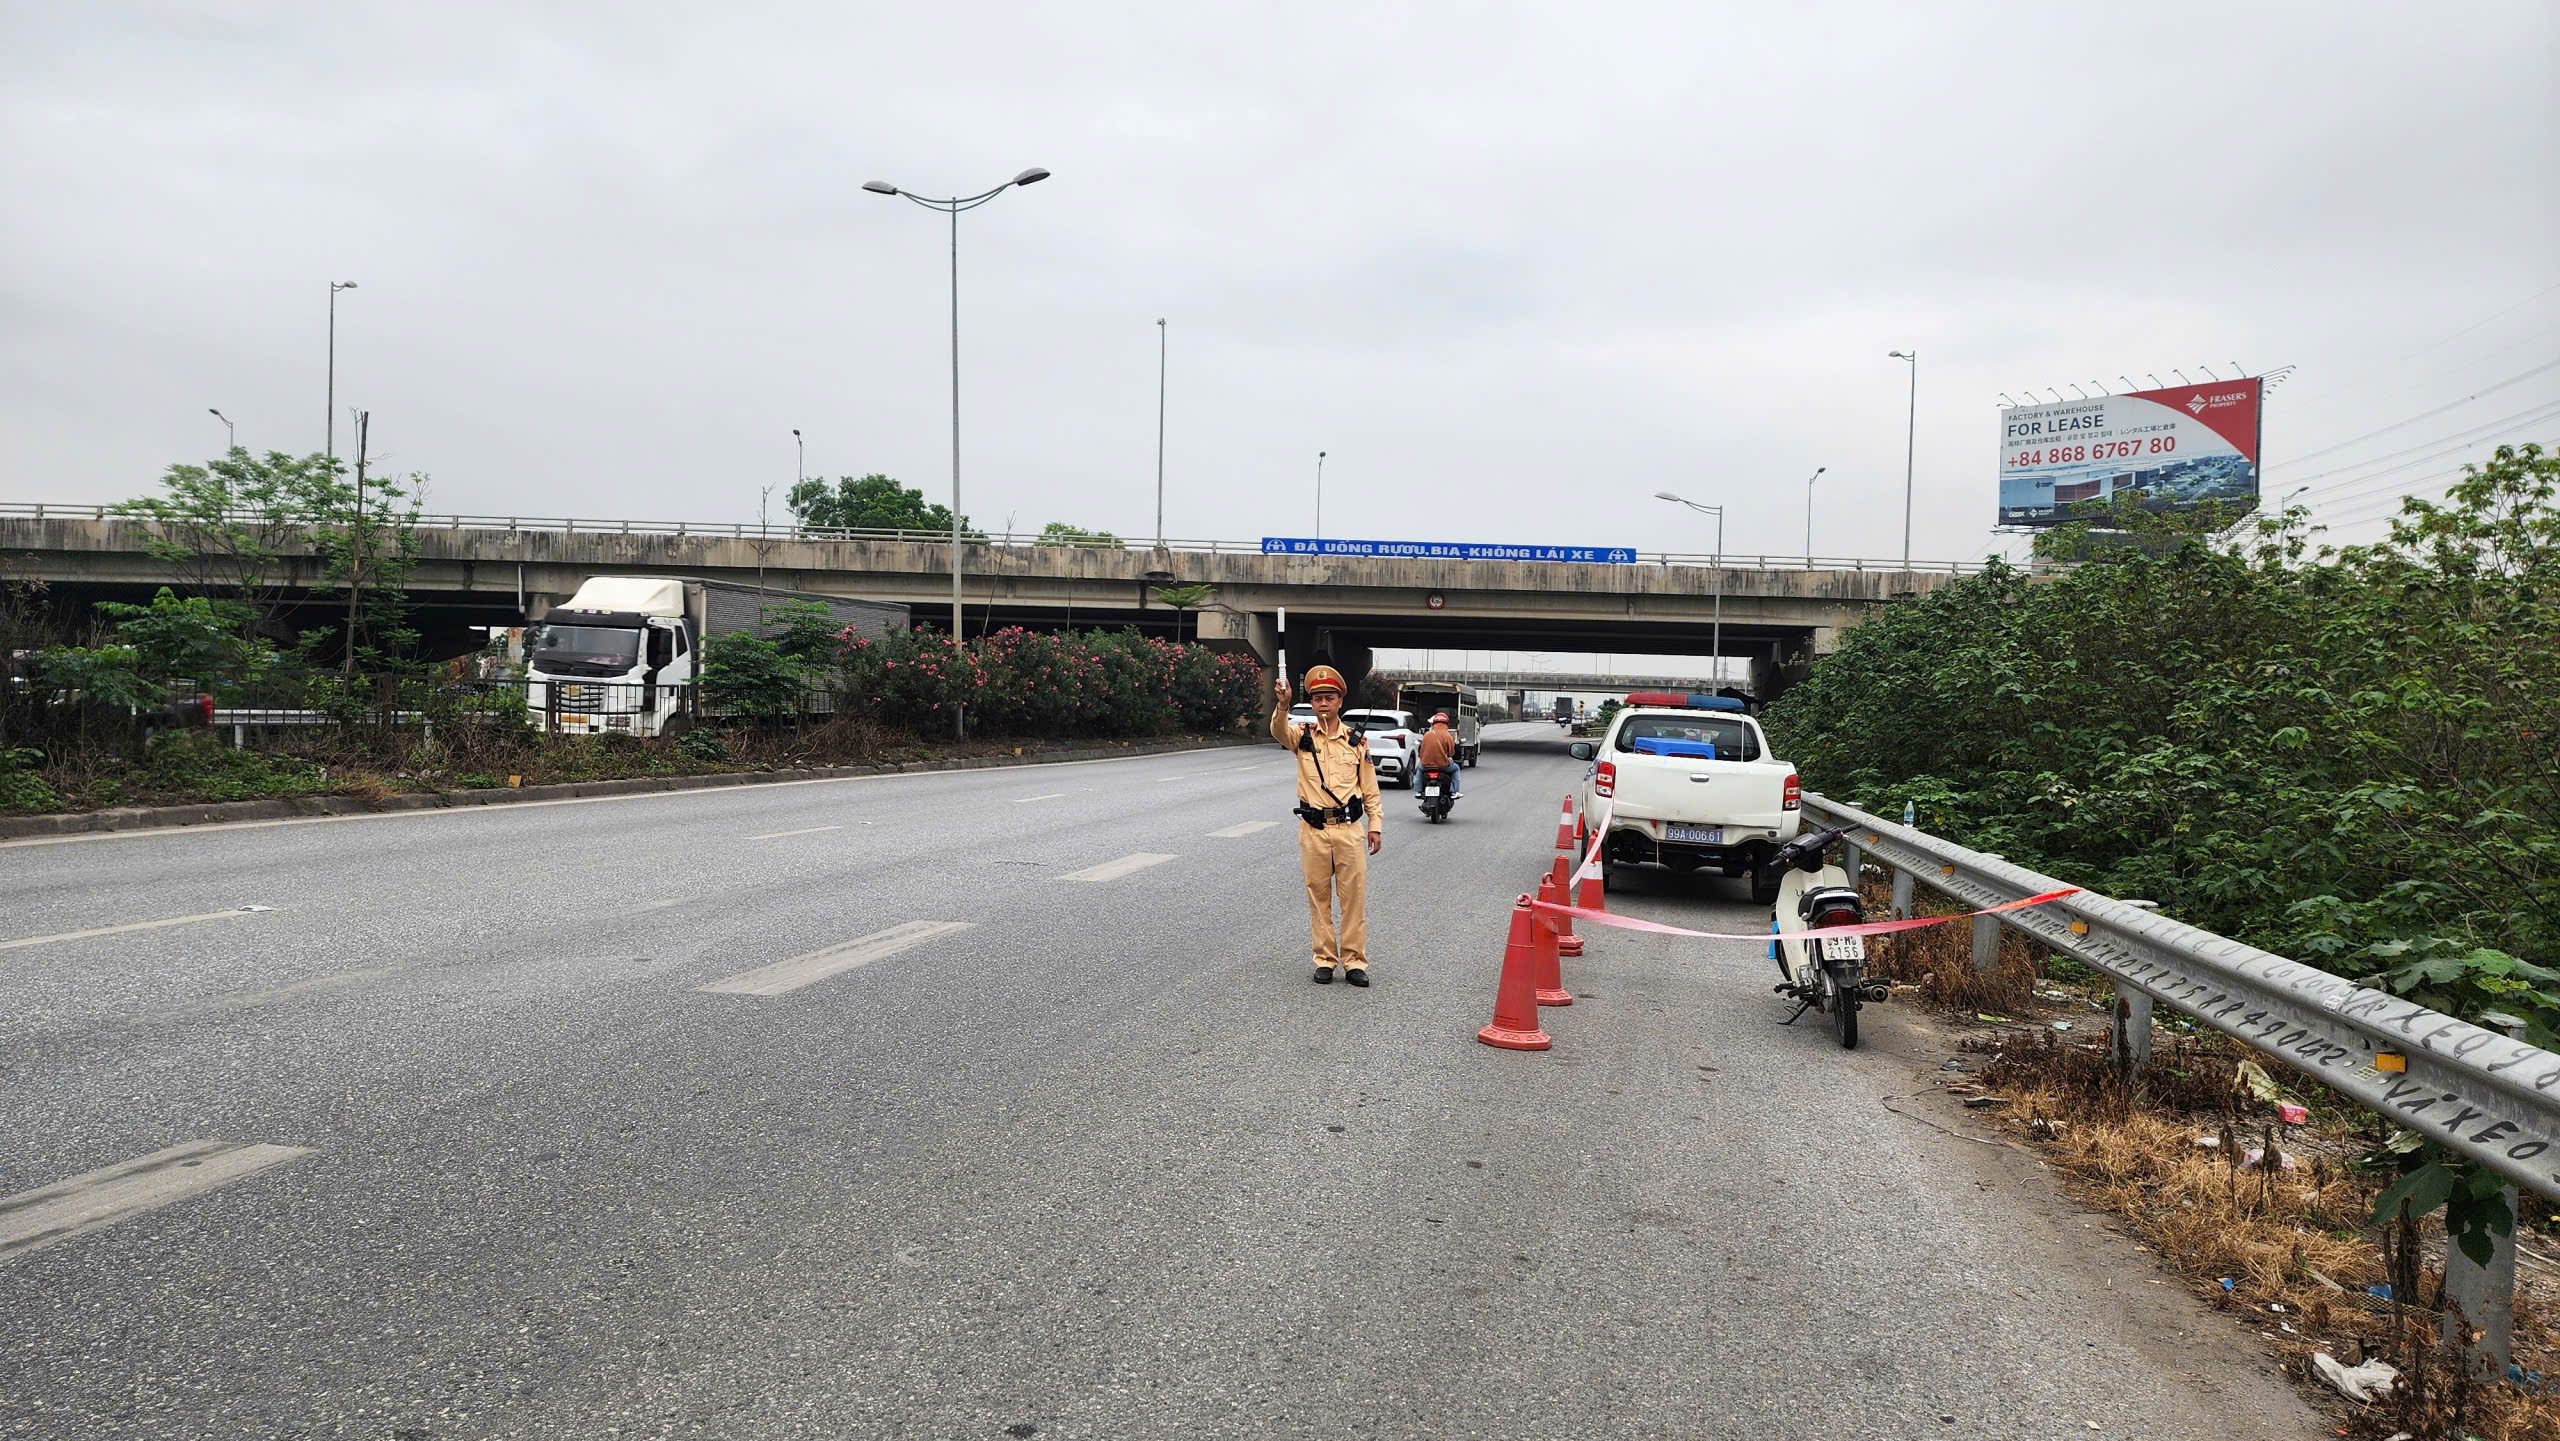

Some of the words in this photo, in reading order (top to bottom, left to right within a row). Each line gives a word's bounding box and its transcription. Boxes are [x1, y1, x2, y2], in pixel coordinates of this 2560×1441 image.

[2210, 392, 2247, 403] FRASERS
[2008, 411, 2044, 422] FACTORY
[2053, 404, 2104, 417] WAREHOUSE
[2008, 422, 2042, 437] FOR
[2048, 414, 2104, 433] LEASE
[2008, 450, 2042, 467] +84
[2048, 445, 2085, 464] 868
[2092, 439, 2142, 460] 6767
[2150, 436, 2176, 454] 80
[1294, 540, 1319, 552] ĐÃ
[1325, 540, 1373, 553] UỐNG
[1535, 546, 1565, 559] LÁI
[1571, 550, 1595, 560] XE
[1829, 946, 1859, 958] 2156
